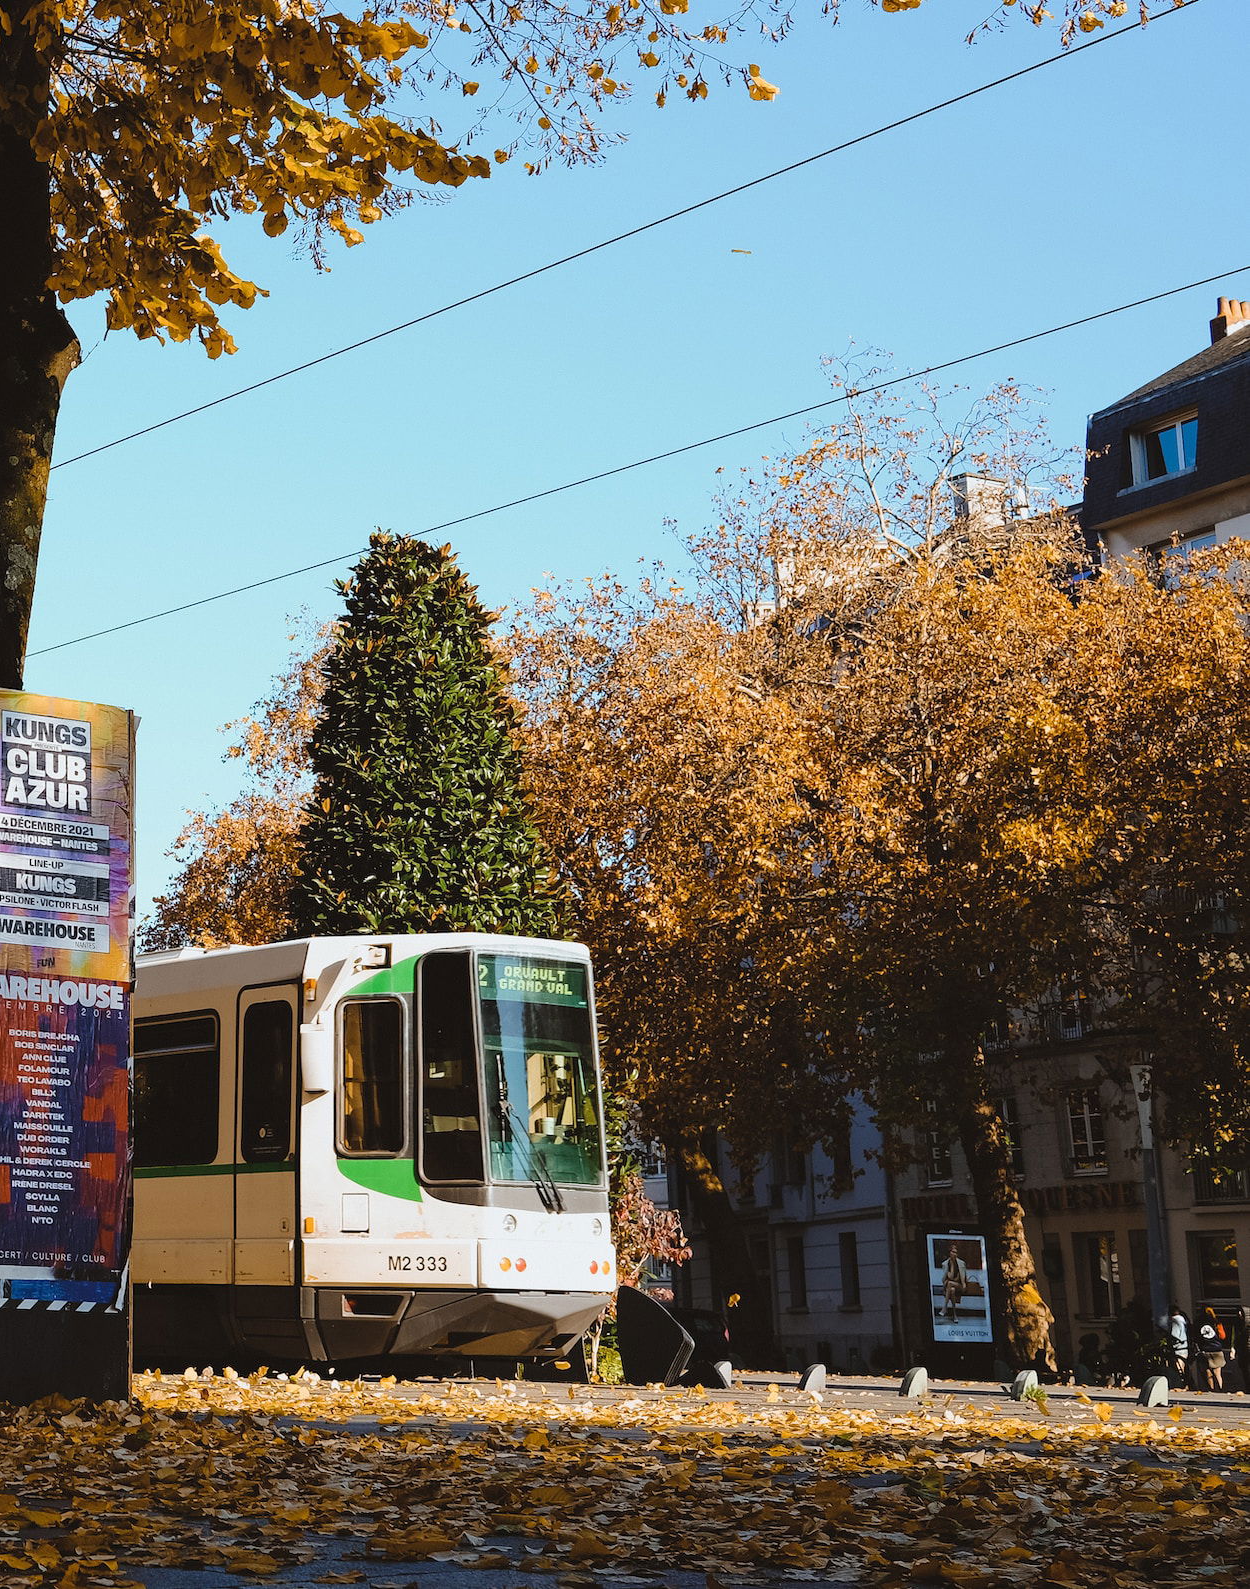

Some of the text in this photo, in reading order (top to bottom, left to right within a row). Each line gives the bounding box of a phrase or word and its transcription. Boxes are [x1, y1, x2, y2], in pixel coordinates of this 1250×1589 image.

[5, 716, 87, 747] KUNGS
[6, 748, 87, 782] CLUB
[5, 776, 89, 811] AZUR
[1, 816, 94, 836] 4 DÉCEMBRE 2021
[29, 859, 64, 870] LINE-UP
[15, 873, 77, 895] KUNGS
[40, 898, 71, 909] VICTOR
[72, 902, 99, 912] FLASH
[74, 941, 96, 949] NANTES
[36, 957, 55, 968] FUN
[478, 964, 488, 987] 2
[504, 965, 566, 982] ORVAULT
[499, 978, 573, 995] GRAND VAL
[81, 1008, 122, 1020] 2021
[9, 1029, 80, 1042] BORIS BREJCHA
[35, 1043, 74, 1052] SINCLAR
[22, 1053, 67, 1063] ANN CLUE
[18, 1064, 70, 1075] FOLAMOUR
[17, 1075, 71, 1086] TEO LAVABO
[32, 1088, 56, 1097] BILLX
[25, 1099, 62, 1109] VANDAL
[22, 1110, 64, 1120] DARKTEK
[13, 1122, 73, 1132] MAISSOUILLE
[17, 1133, 70, 1144] DUB ORDER
[926, 1100, 942, 1175] HTEL
[19, 1145, 67, 1155] WORAKLS
[23, 1157, 52, 1166] DEREK
[12, 1168, 73, 1179] HADRA X EDC
[39, 1182, 74, 1191] DRESEL
[25, 1192, 60, 1201] SCYLLA
[26, 1204, 58, 1213] BLANC
[31, 1216, 54, 1225] N'TO
[31, 1252, 72, 1261] CULTURE
[81, 1254, 106, 1263] CLUB
[388, 1255, 448, 1272] M2 333
